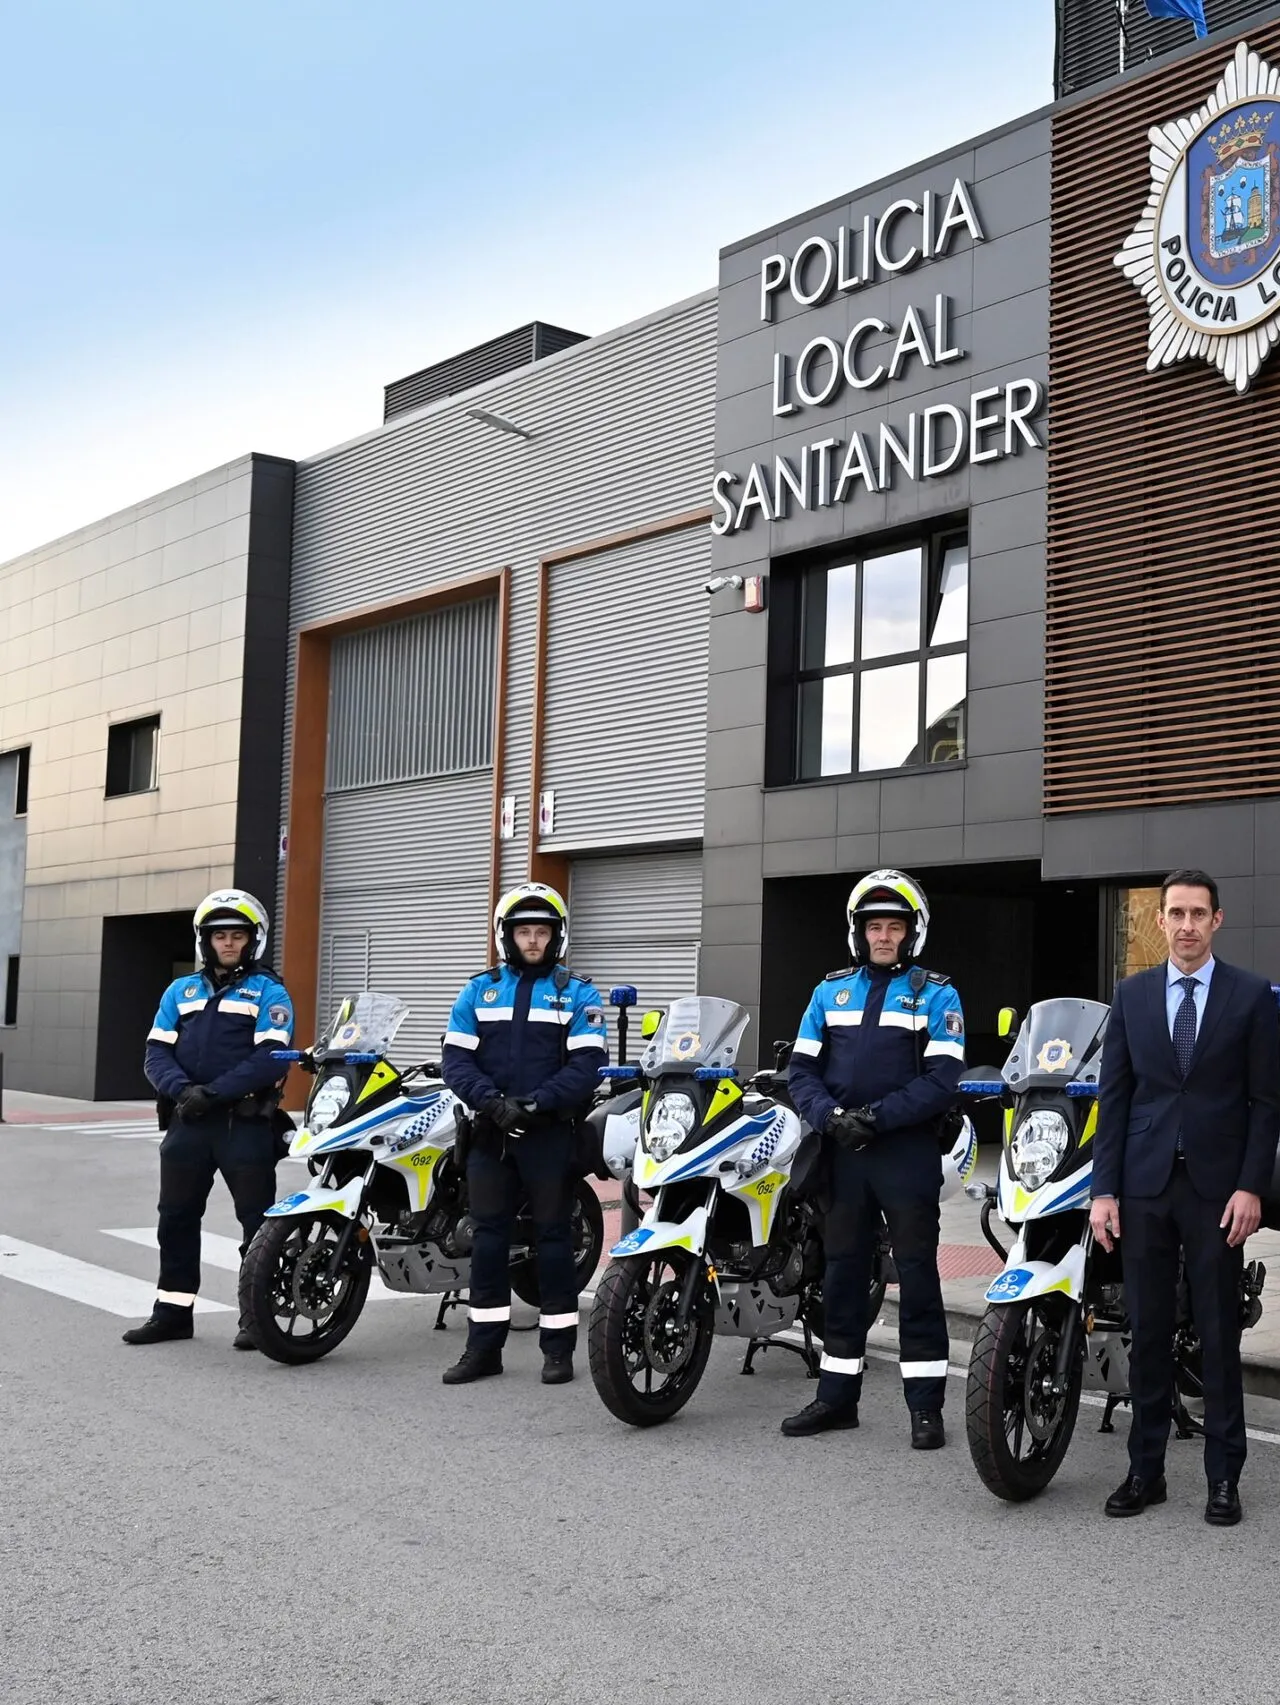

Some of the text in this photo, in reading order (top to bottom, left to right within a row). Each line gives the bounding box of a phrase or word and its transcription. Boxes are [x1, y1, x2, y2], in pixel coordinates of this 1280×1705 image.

[760, 178, 984, 322] POLICIA
[1161, 235, 1238, 322] POLICIA
[773, 293, 965, 417] LOCAL
[710, 378, 1043, 535] SANTANDER
[543, 994, 572, 1003] POLCIA
[413, 1155, 432, 1167] 092
[757, 1182, 775, 1195] 092
[989, 1283, 1020, 1296] 092
